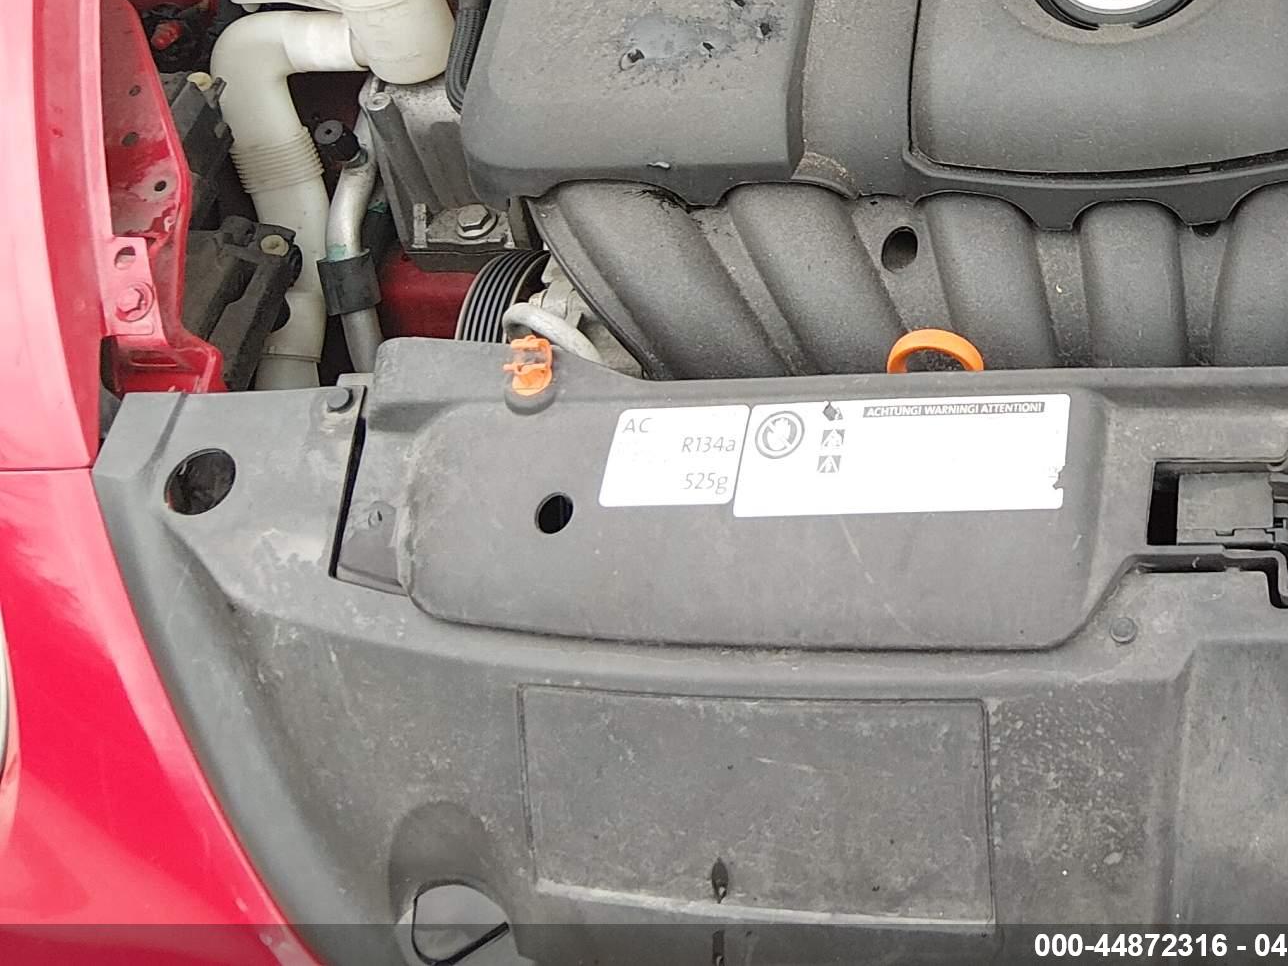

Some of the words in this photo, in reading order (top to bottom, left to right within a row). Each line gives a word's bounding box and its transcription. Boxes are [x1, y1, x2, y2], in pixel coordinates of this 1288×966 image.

[866, 405, 921, 418] ACHTUNG!
[924, 403, 979, 416] WARNING!
[981, 401, 1041, 414] ATTENTION!
[622, 417, 653, 434] AC
[681, 436, 736, 453] R134a
[683, 472, 728, 495] 525g
